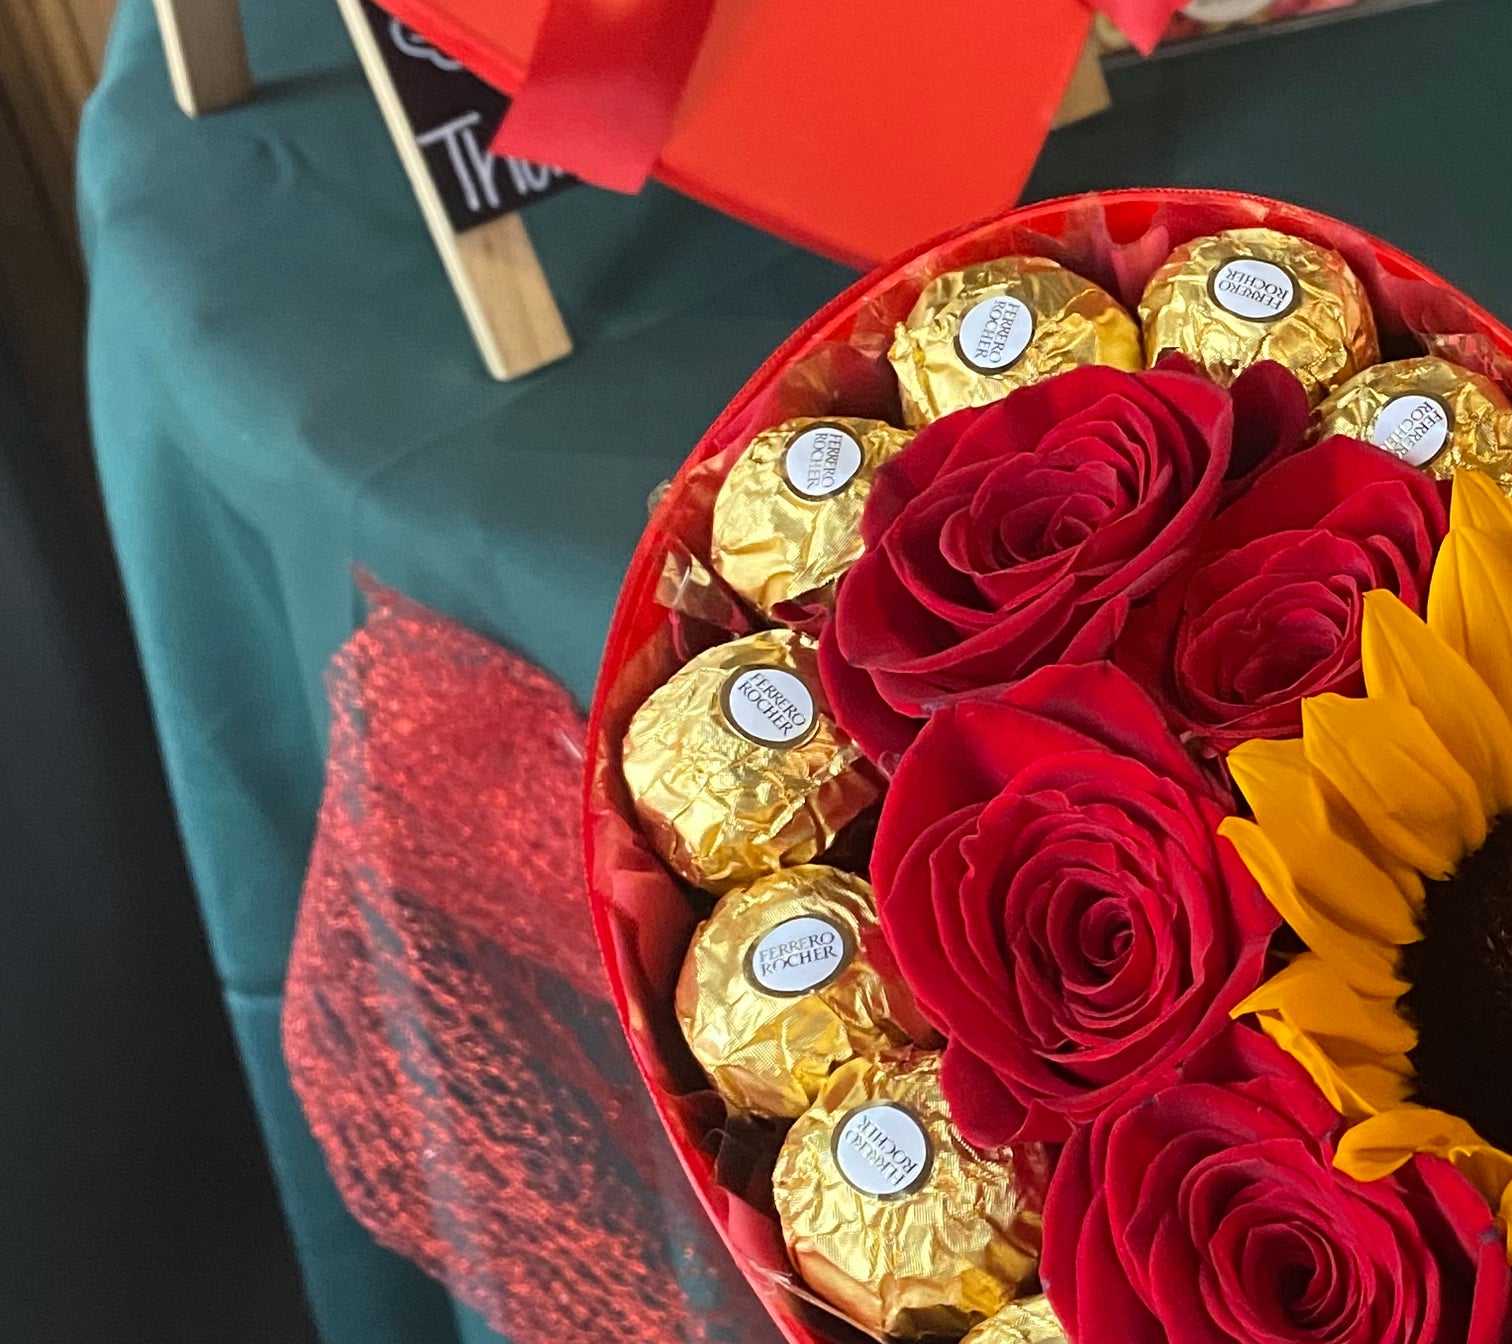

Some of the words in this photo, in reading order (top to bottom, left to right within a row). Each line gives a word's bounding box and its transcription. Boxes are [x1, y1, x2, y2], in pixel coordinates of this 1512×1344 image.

[1218, 279, 1283, 311] FERRERO
[1226, 268, 1289, 300] ROCHER
[974, 299, 1007, 359] ROCHER
[989, 303, 1020, 364] FERRERO
[807, 433, 828, 490] ROCHER
[821, 433, 843, 488] FERRERO
[1393, 409, 1443, 459] FERRER
[738, 680, 793, 736] ROCHER
[749, 673, 806, 727] FERRERO
[759, 931, 834, 962] FERRERO
[762, 945, 837, 976] ROCHER
[845, 1129, 905, 1187] FERRERO
[859, 1115, 918, 1174] ROCHER
